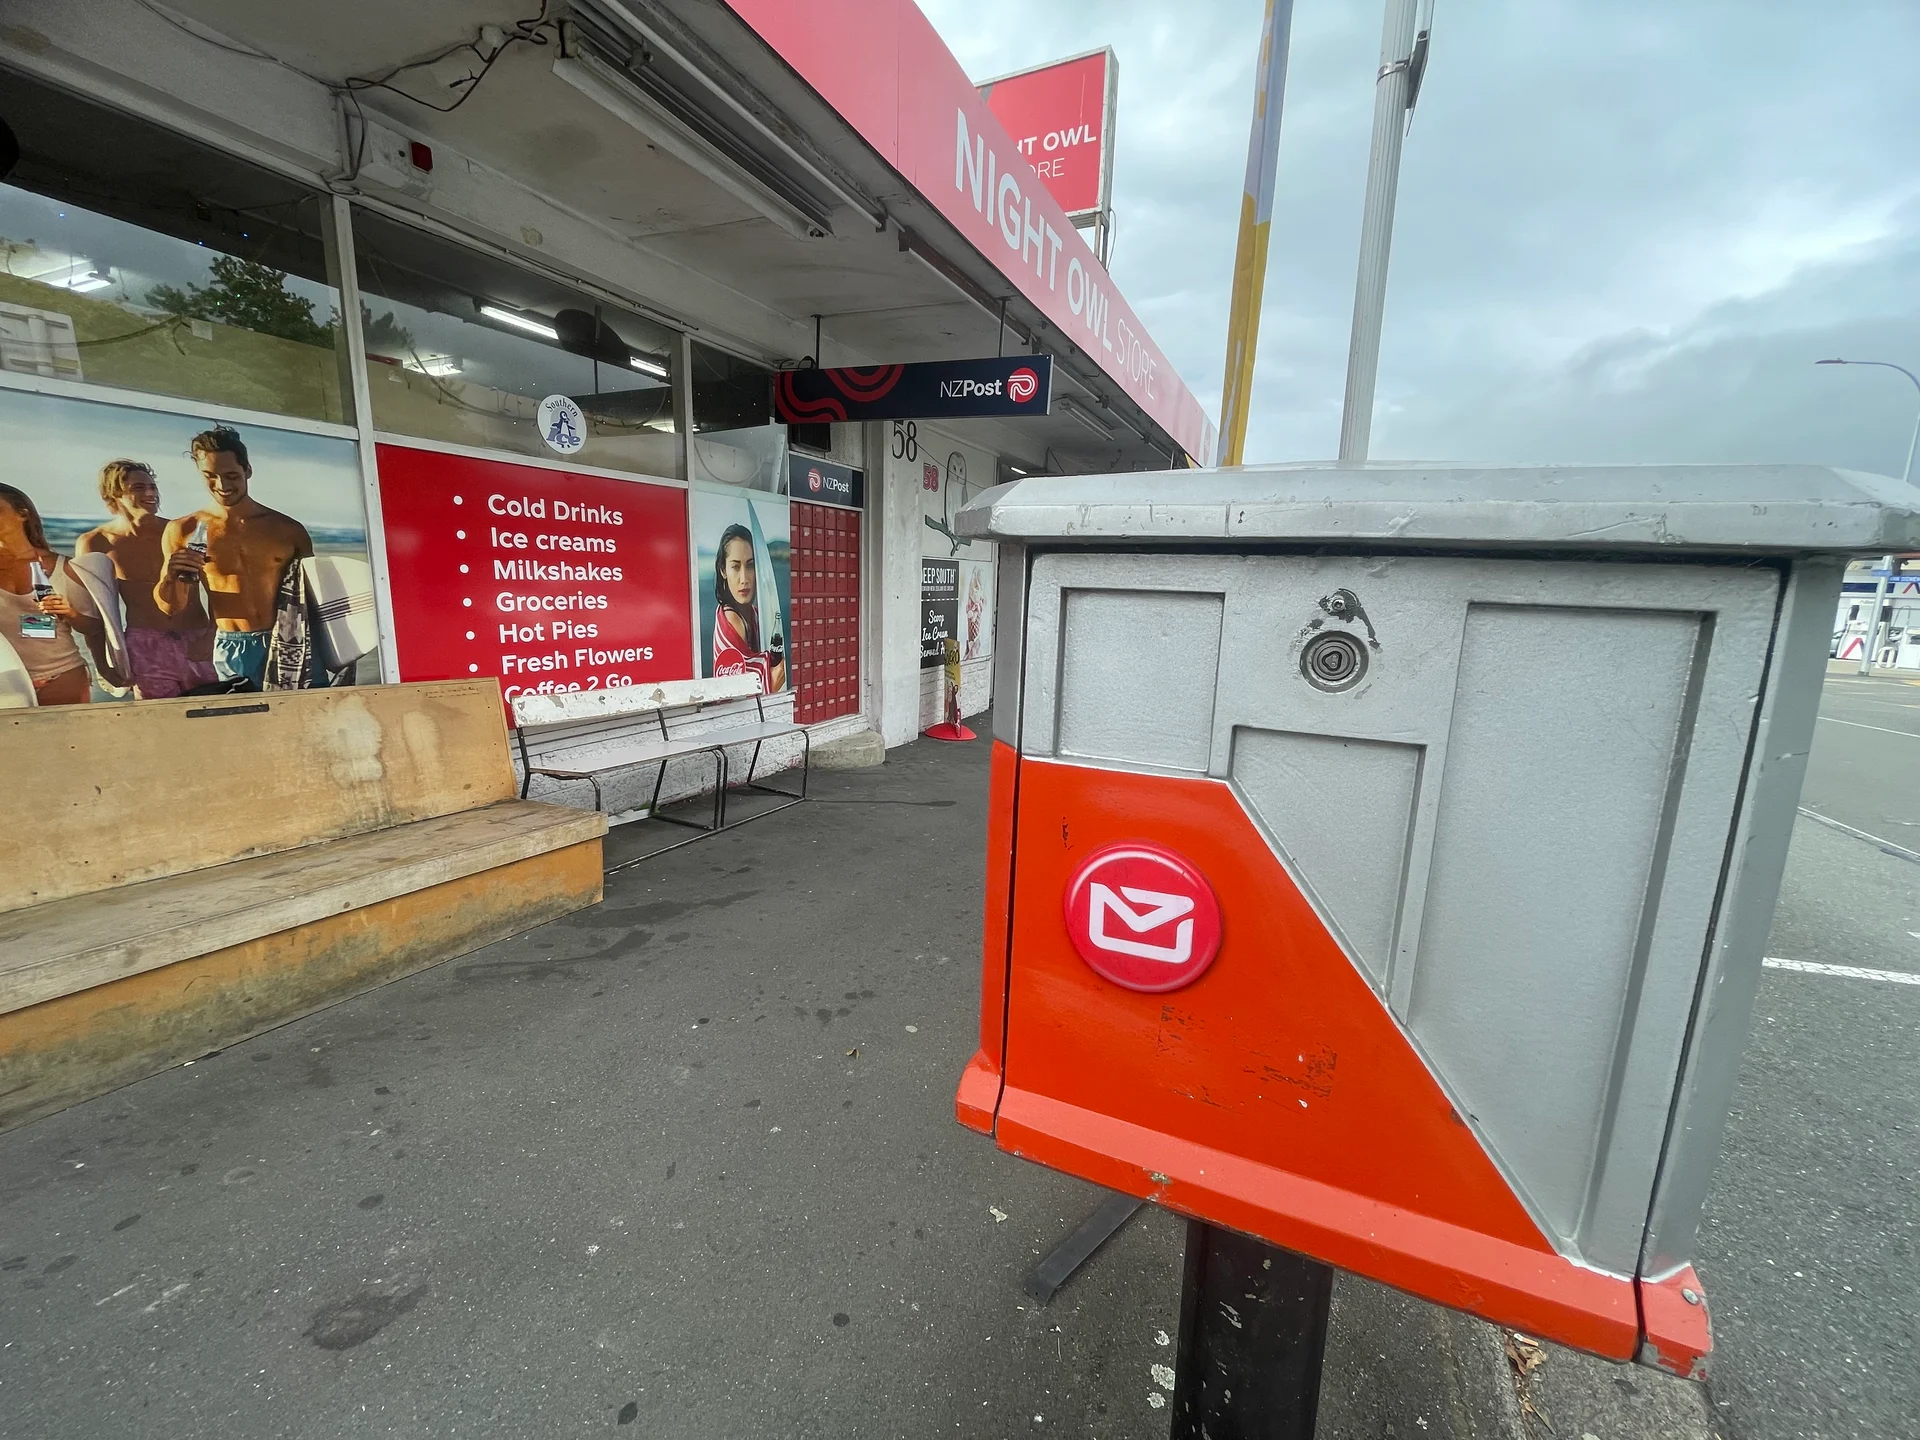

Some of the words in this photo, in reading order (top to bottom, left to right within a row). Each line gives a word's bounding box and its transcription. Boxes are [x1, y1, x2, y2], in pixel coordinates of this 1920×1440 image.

[1042, 124, 1097, 151] OWL
[955, 107, 1062, 291] NIGHT
[1067, 257, 1112, 352] OWL
[1115, 318, 1157, 400] STORE
[940, 379, 1003, 398] NZPost
[545, 398, 578, 417] Southern
[891, 420, 917, 463] 58
[822, 476, 850, 493] NZPost
[922, 462, 939, 493] 58
[487, 494, 546, 519] Cold
[553, 500, 624, 526] Drinks
[490, 527, 529, 550] Ice
[535, 533, 617, 553] creams
[493, 559, 624, 582] Milkshakes
[921, 567, 936, 584] EEP
[935, 568, 956, 584] SOUTH
[495, 590, 609, 613] Groceries
[498, 622, 545, 644] Hot
[551, 619, 599, 641] Pies
[502, 650, 568, 675] Fresh
[574, 646, 654, 667] Flowers
[586, 676, 599, 691] 2
[605, 673, 633, 689] Go
